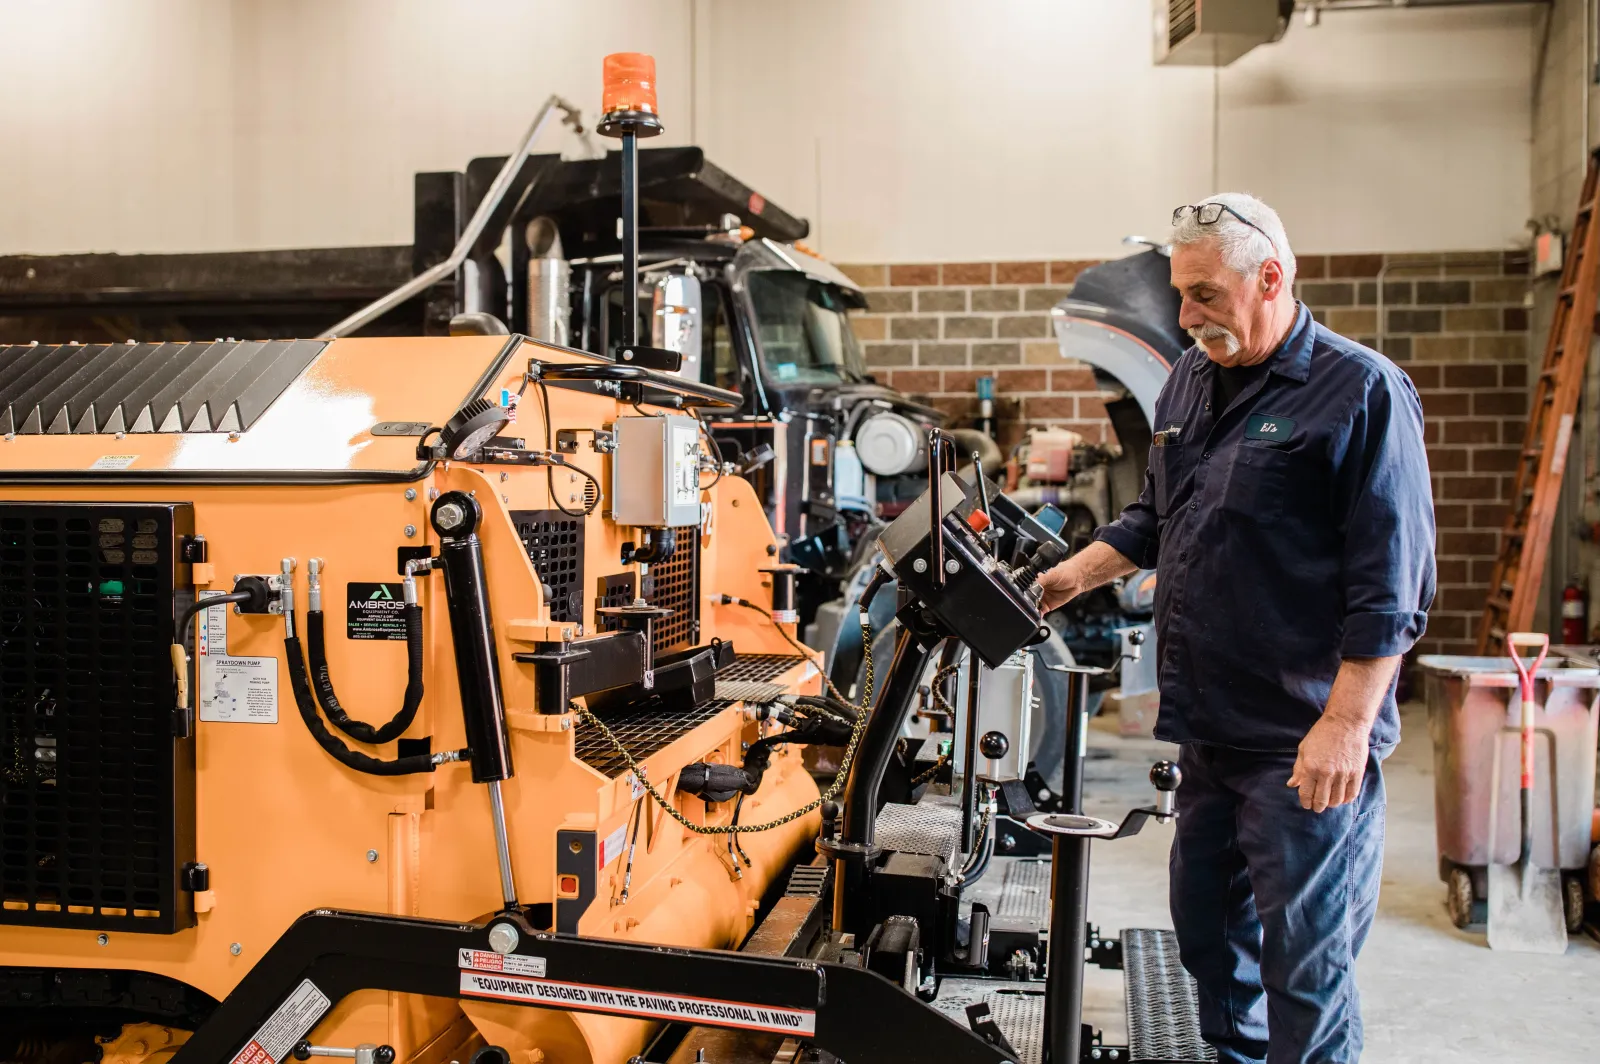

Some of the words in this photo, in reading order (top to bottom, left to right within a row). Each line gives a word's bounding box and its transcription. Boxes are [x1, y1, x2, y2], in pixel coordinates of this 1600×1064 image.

[349, 600, 405, 610] AMBROS
[536, 985, 587, 1002] DESIGNED
[588, 990, 615, 1005] WITH
[616, 994, 637, 1008] THE
[638, 996, 676, 1012] PAVING
[679, 1002, 756, 1022] PROFESSIONAL
[757, 1010, 770, 1024] IN
[235, 1044, 258, 1064] NGER
